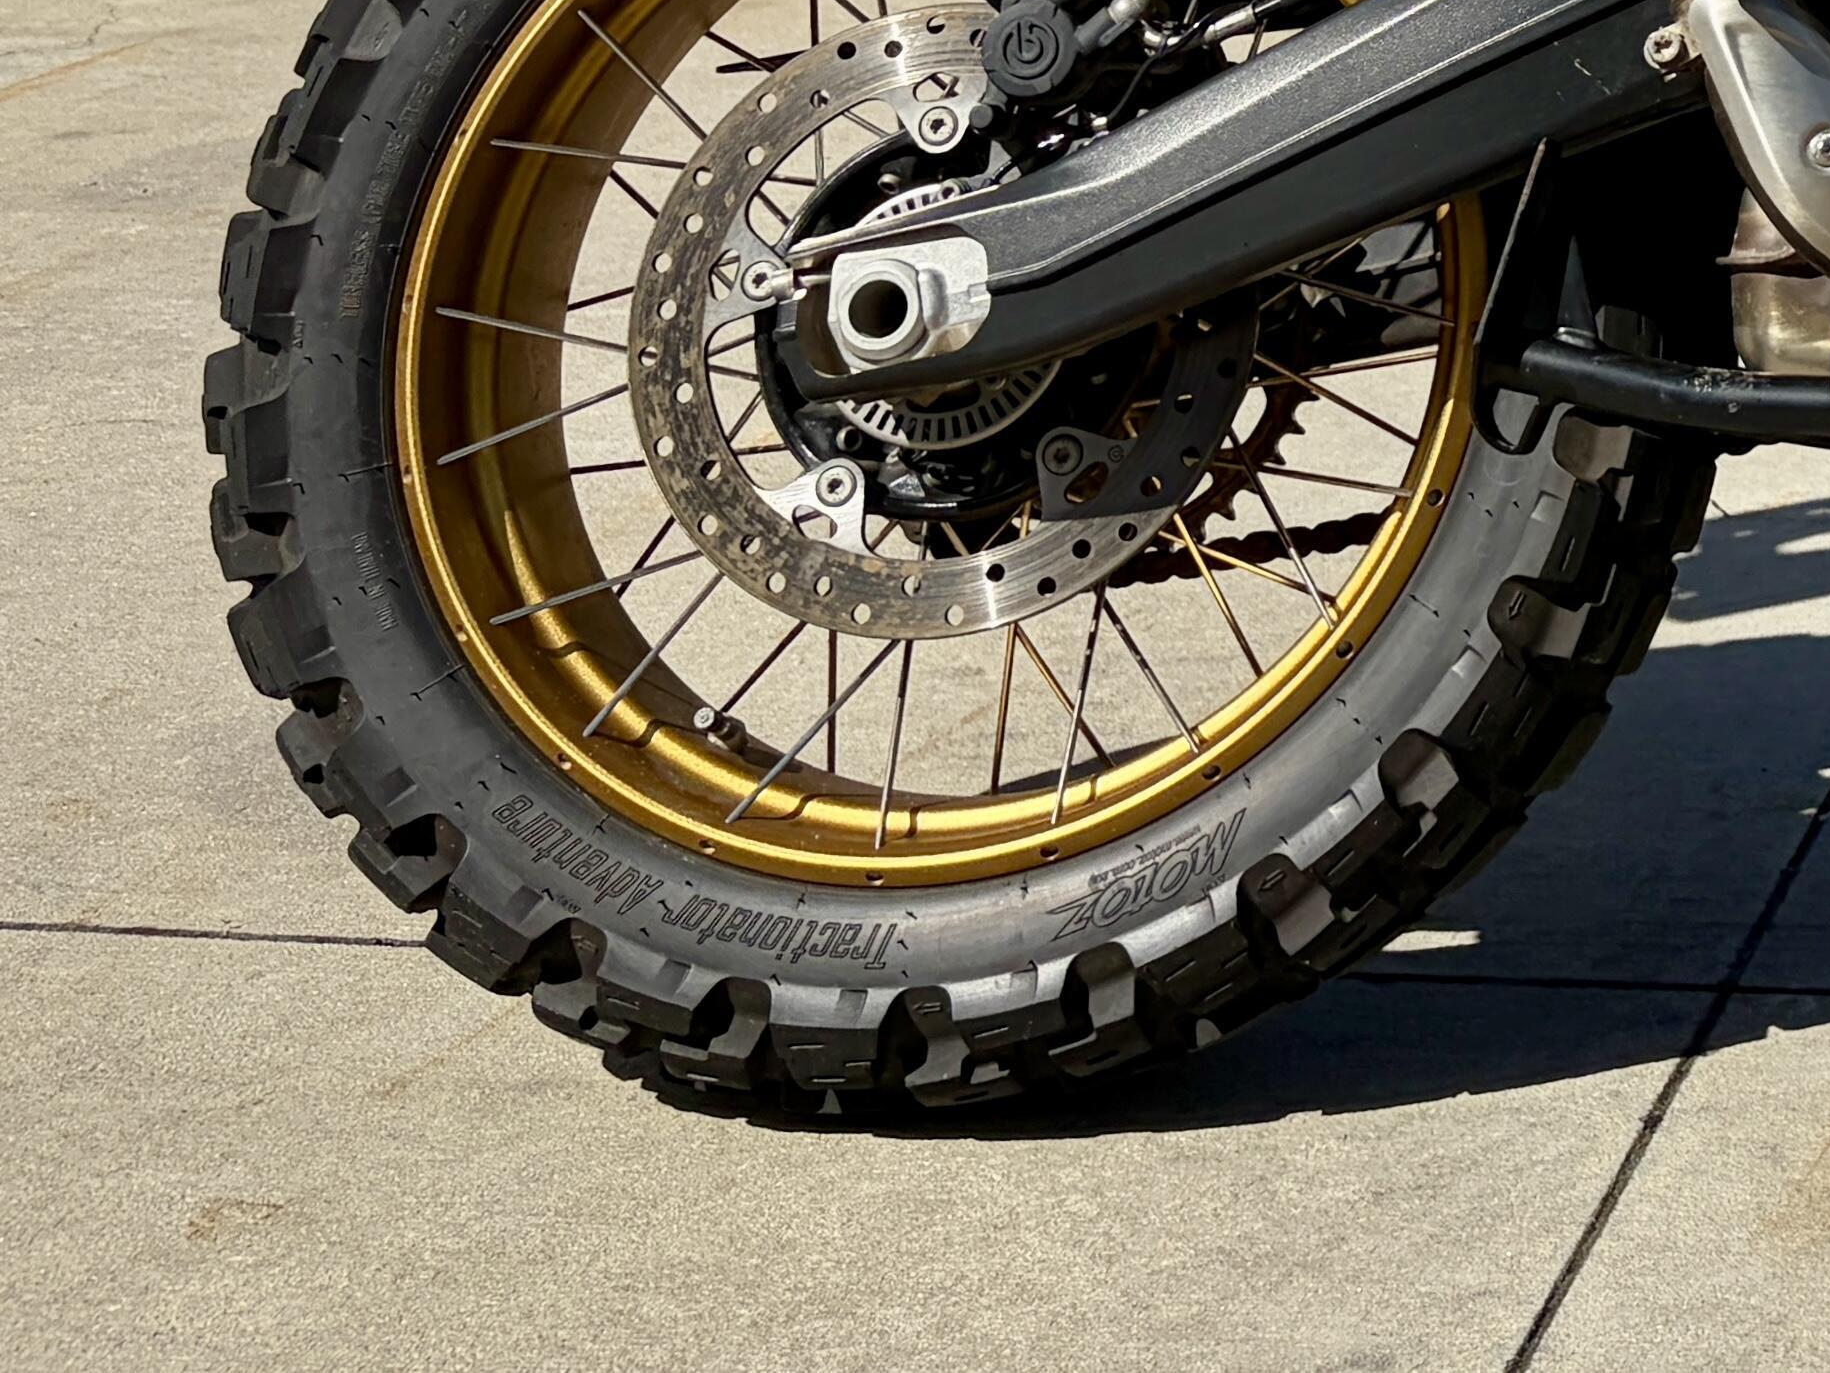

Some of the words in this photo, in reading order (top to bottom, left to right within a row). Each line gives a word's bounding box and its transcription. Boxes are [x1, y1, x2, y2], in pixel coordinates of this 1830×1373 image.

[492, 794, 663, 915] Adventure
[1046, 808, 1247, 942] MOTOZ
[662, 894, 898, 970] Tractionator
